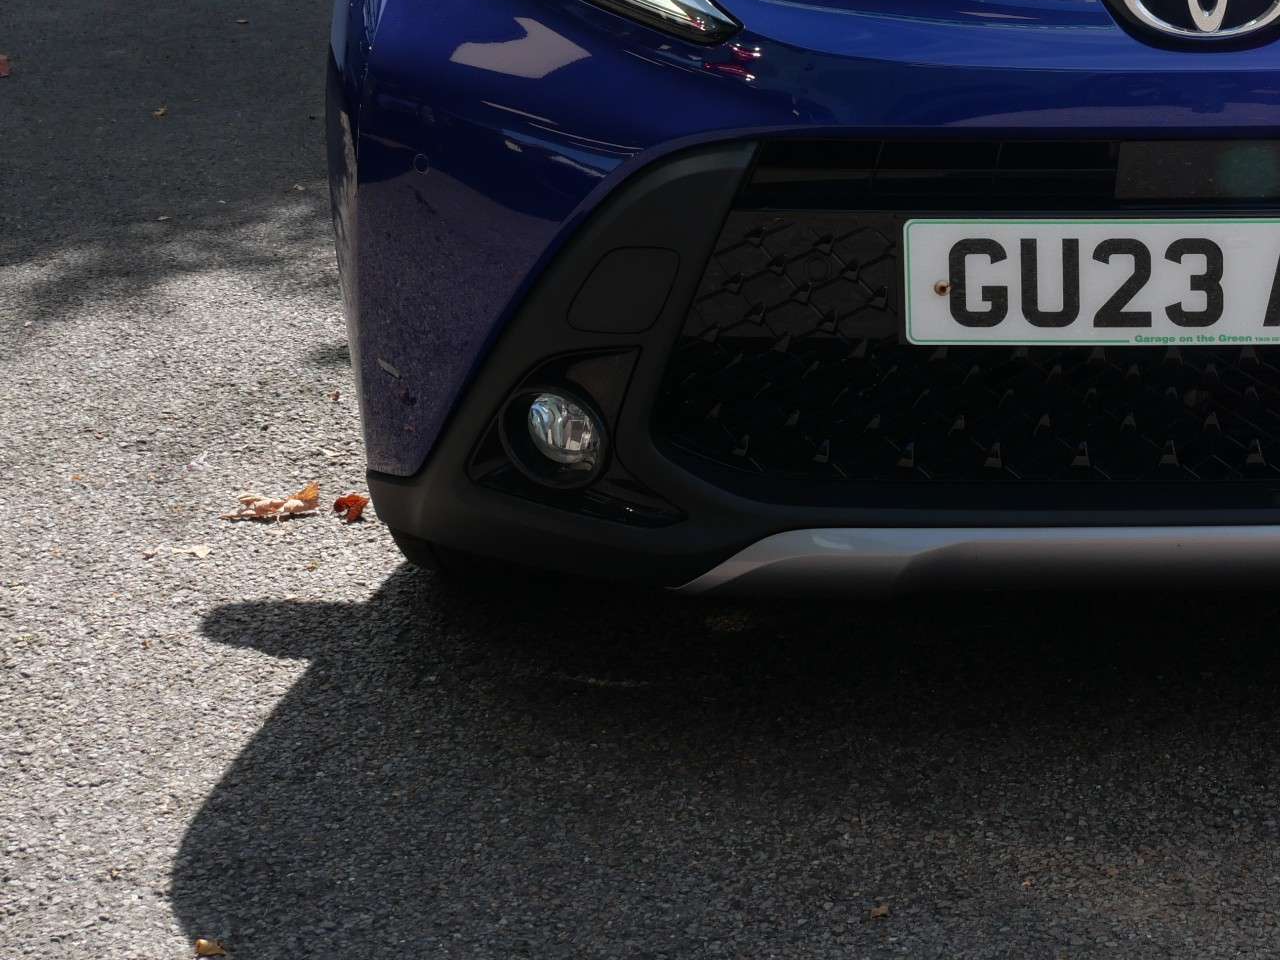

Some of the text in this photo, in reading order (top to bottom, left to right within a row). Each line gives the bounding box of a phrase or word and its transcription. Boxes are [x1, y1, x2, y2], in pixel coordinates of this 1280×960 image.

[948, 237, 1225, 328] GU23
[1135, 334, 1176, 344] Garage
[1196, 334, 1216, 343] the
[1218, 333, 1252, 343] Green
